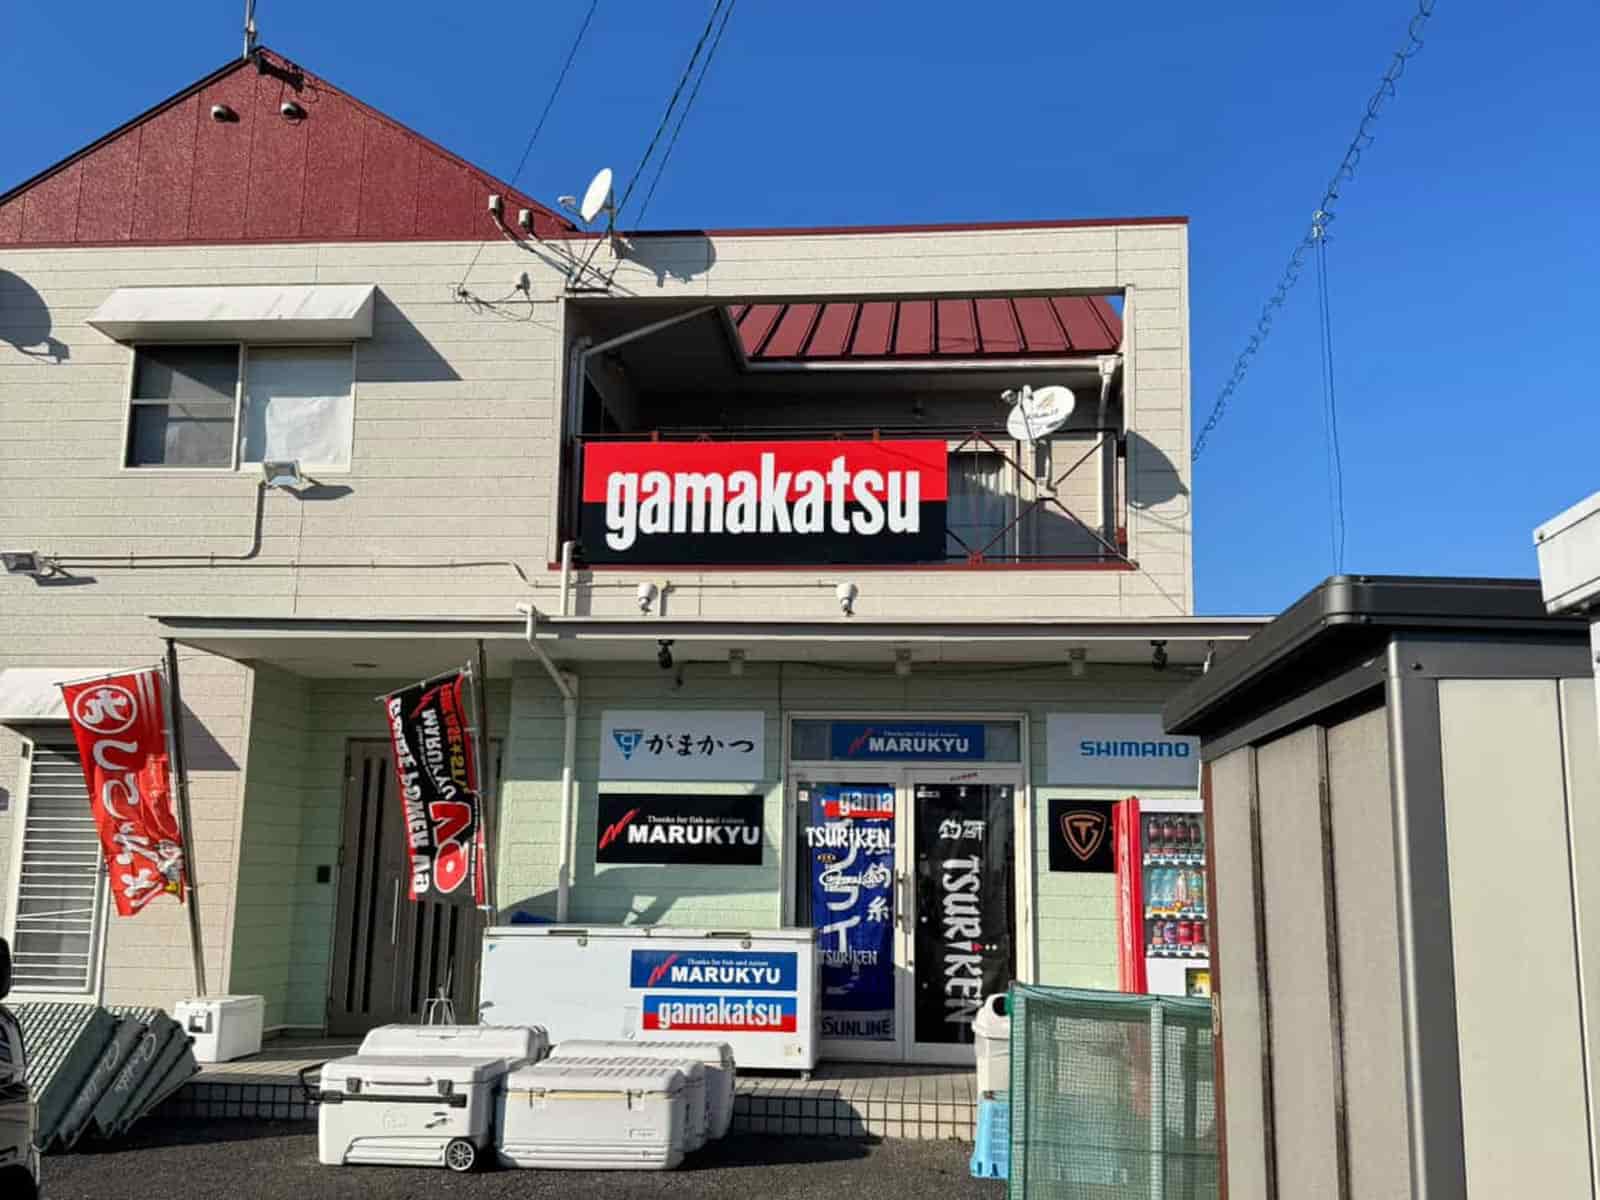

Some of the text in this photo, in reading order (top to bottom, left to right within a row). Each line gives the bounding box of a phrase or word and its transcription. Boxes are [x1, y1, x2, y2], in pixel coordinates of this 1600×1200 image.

[605, 452, 920, 551] gamakatsu
[645, 733, 755, 756] がまかつ
[869, 737, 969, 752] MARUKYU
[1080, 740, 1190, 758] SHIMANO
[627, 823, 760, 845] MARUKYU
[671, 965, 781, 985] MARUKYU
[657, 997, 783, 1028] gamakatsu
